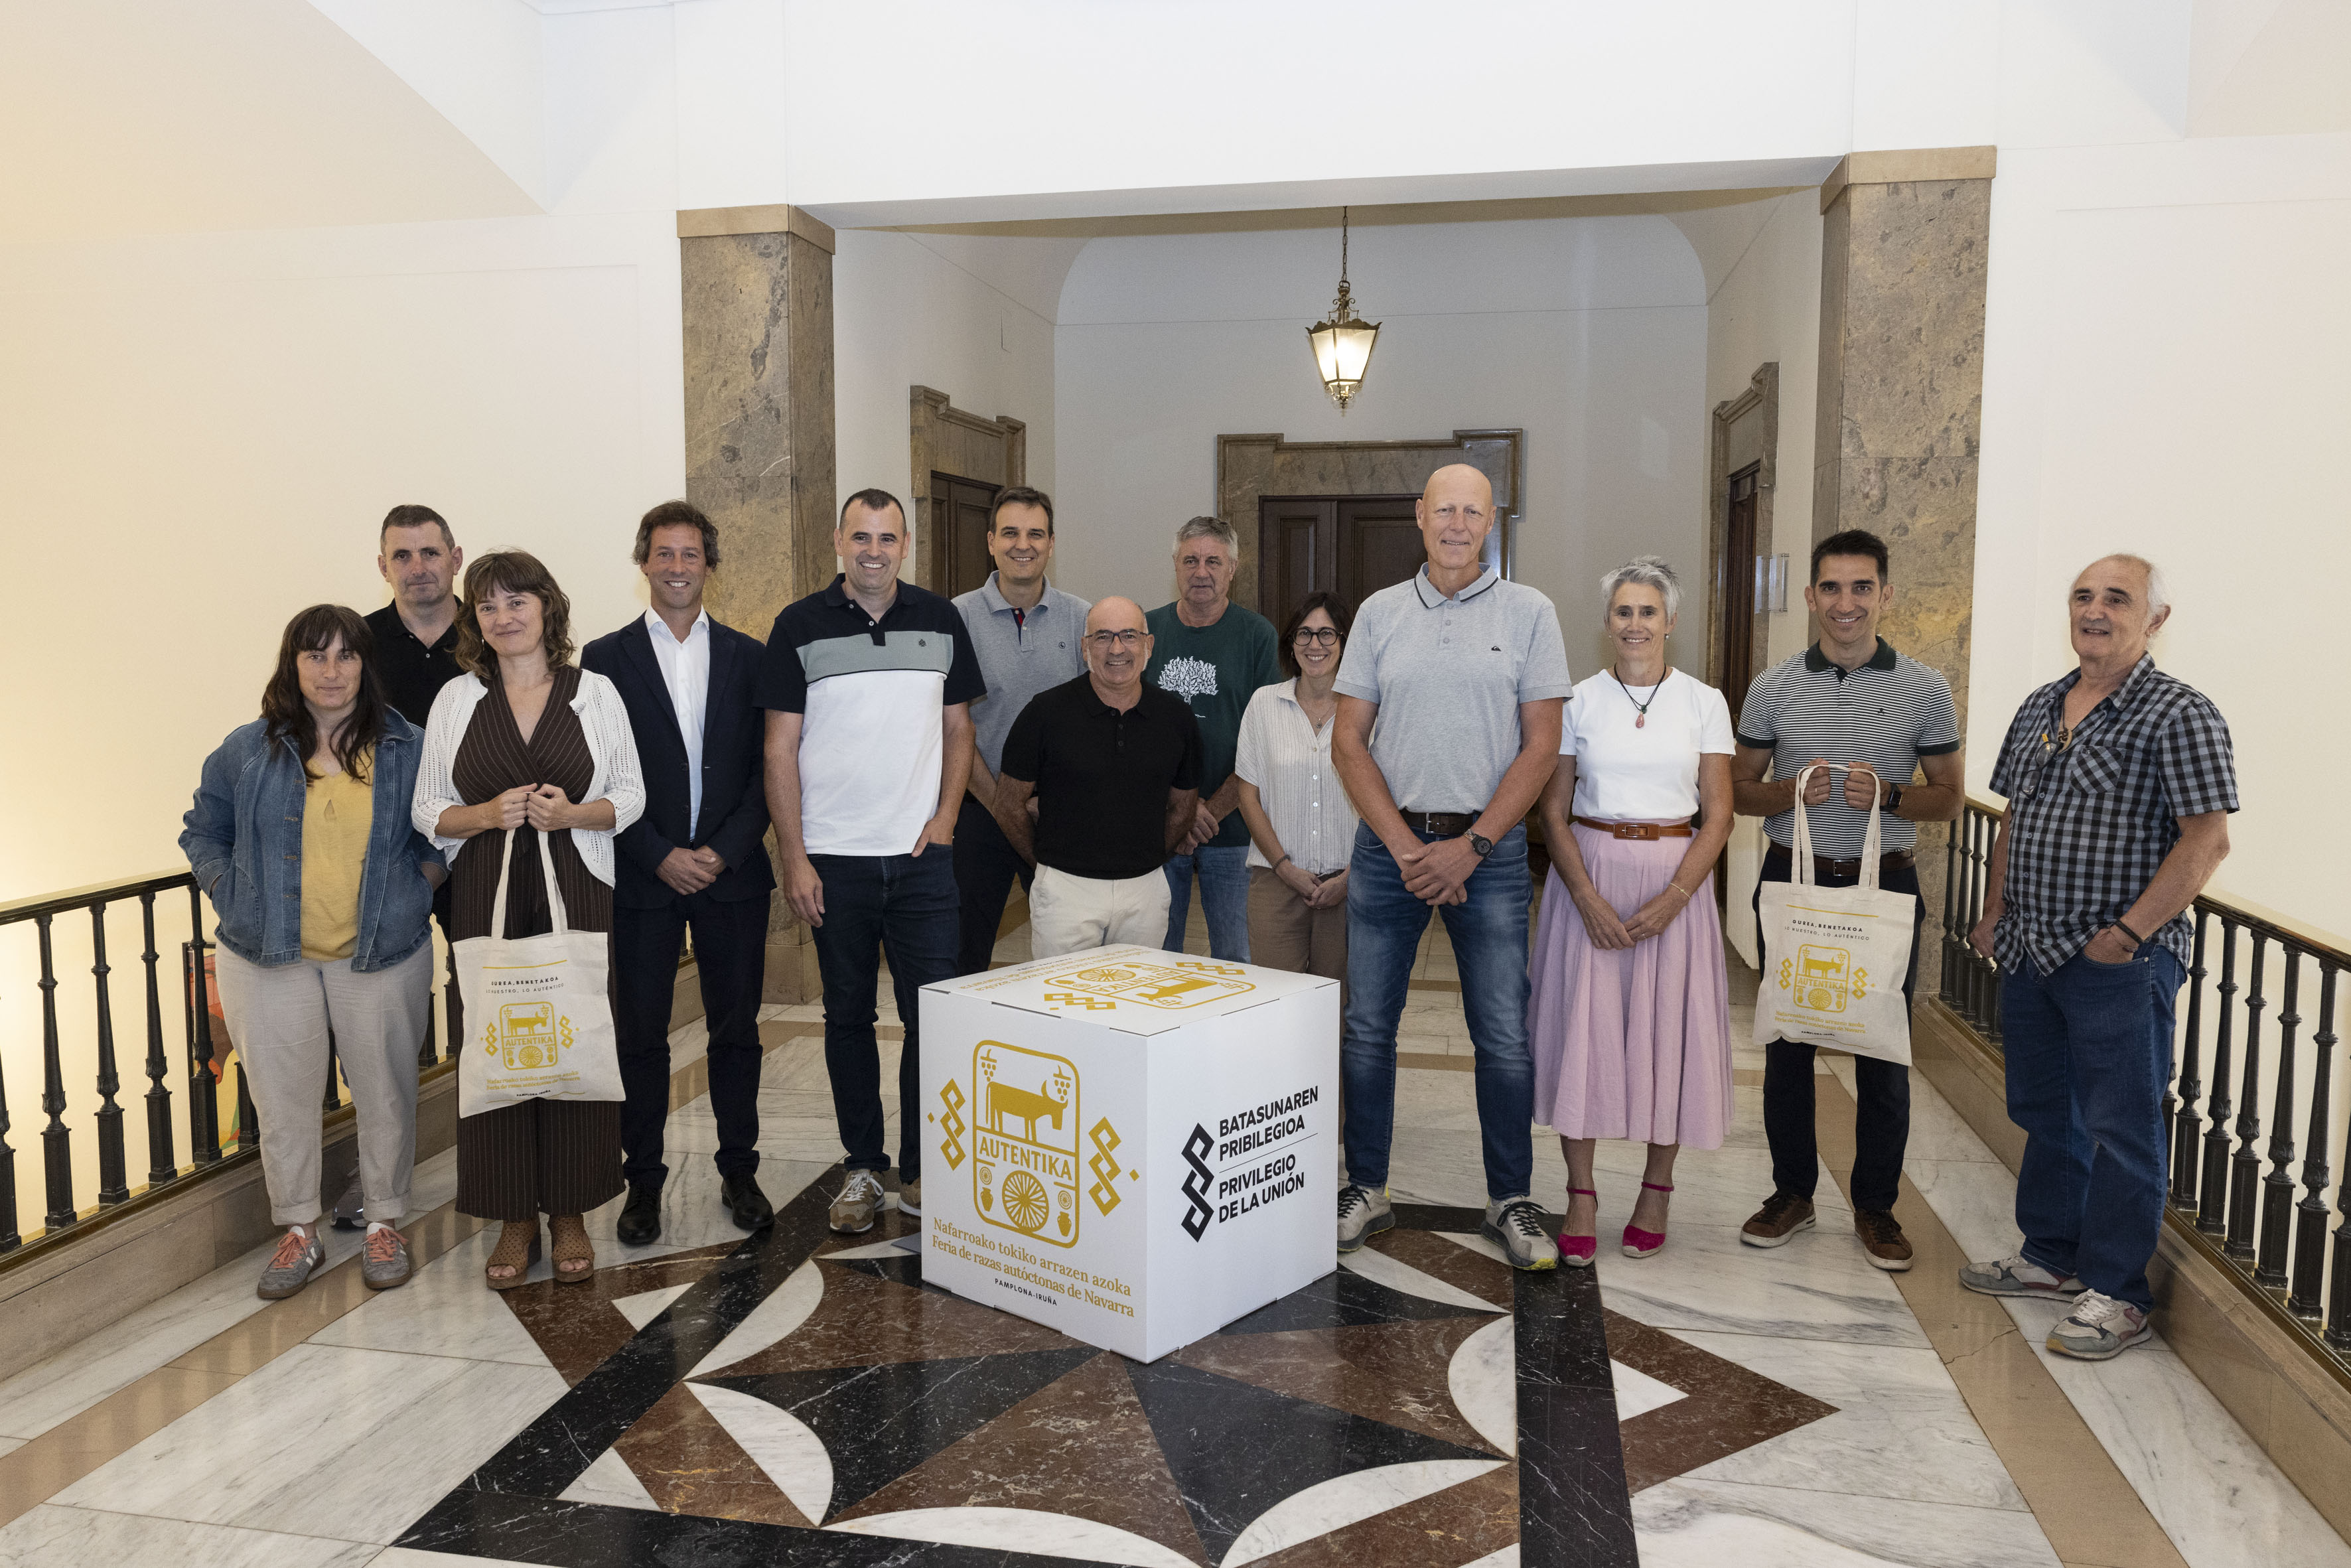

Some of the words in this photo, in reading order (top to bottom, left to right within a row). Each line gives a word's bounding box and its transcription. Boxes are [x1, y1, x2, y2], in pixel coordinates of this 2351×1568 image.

[1092, 970, 1180, 992] AUTENTIKA
[1798, 977, 1844, 990] AUTENTIKA
[506, 1036, 553, 1046] AUTENTIKA
[1220, 1086, 1318, 1137] BATASUNAREN
[979, 1136, 1072, 1181] AUTENTIKA
[1220, 1115, 1305, 1161] PRIBILEGIOA
[1219, 1154, 1296, 1200] PRIVILEGIO
[1219, 1200, 1238, 1224] DE
[1242, 1192, 1259, 1214] LA
[1262, 1172, 1305, 1204] UNIÓN
[932, 1235, 958, 1256] Feria
[959, 1245, 971, 1261] de
[973, 1253, 1002, 1271] razas
[1003, 1264, 1065, 1294] autóctonas
[1067, 1283, 1082, 1300] de
[1084, 1289, 1135, 1318] Navarra
[934, 1217, 995, 1251] Nafarroako
[998, 1242, 1036, 1265] tokiko
[1040, 1258, 1089, 1283] arrazen
[1092, 1278, 1131, 1297] azoka
[995, 1278, 1057, 1307] PAMPLONA-IRUÑA
